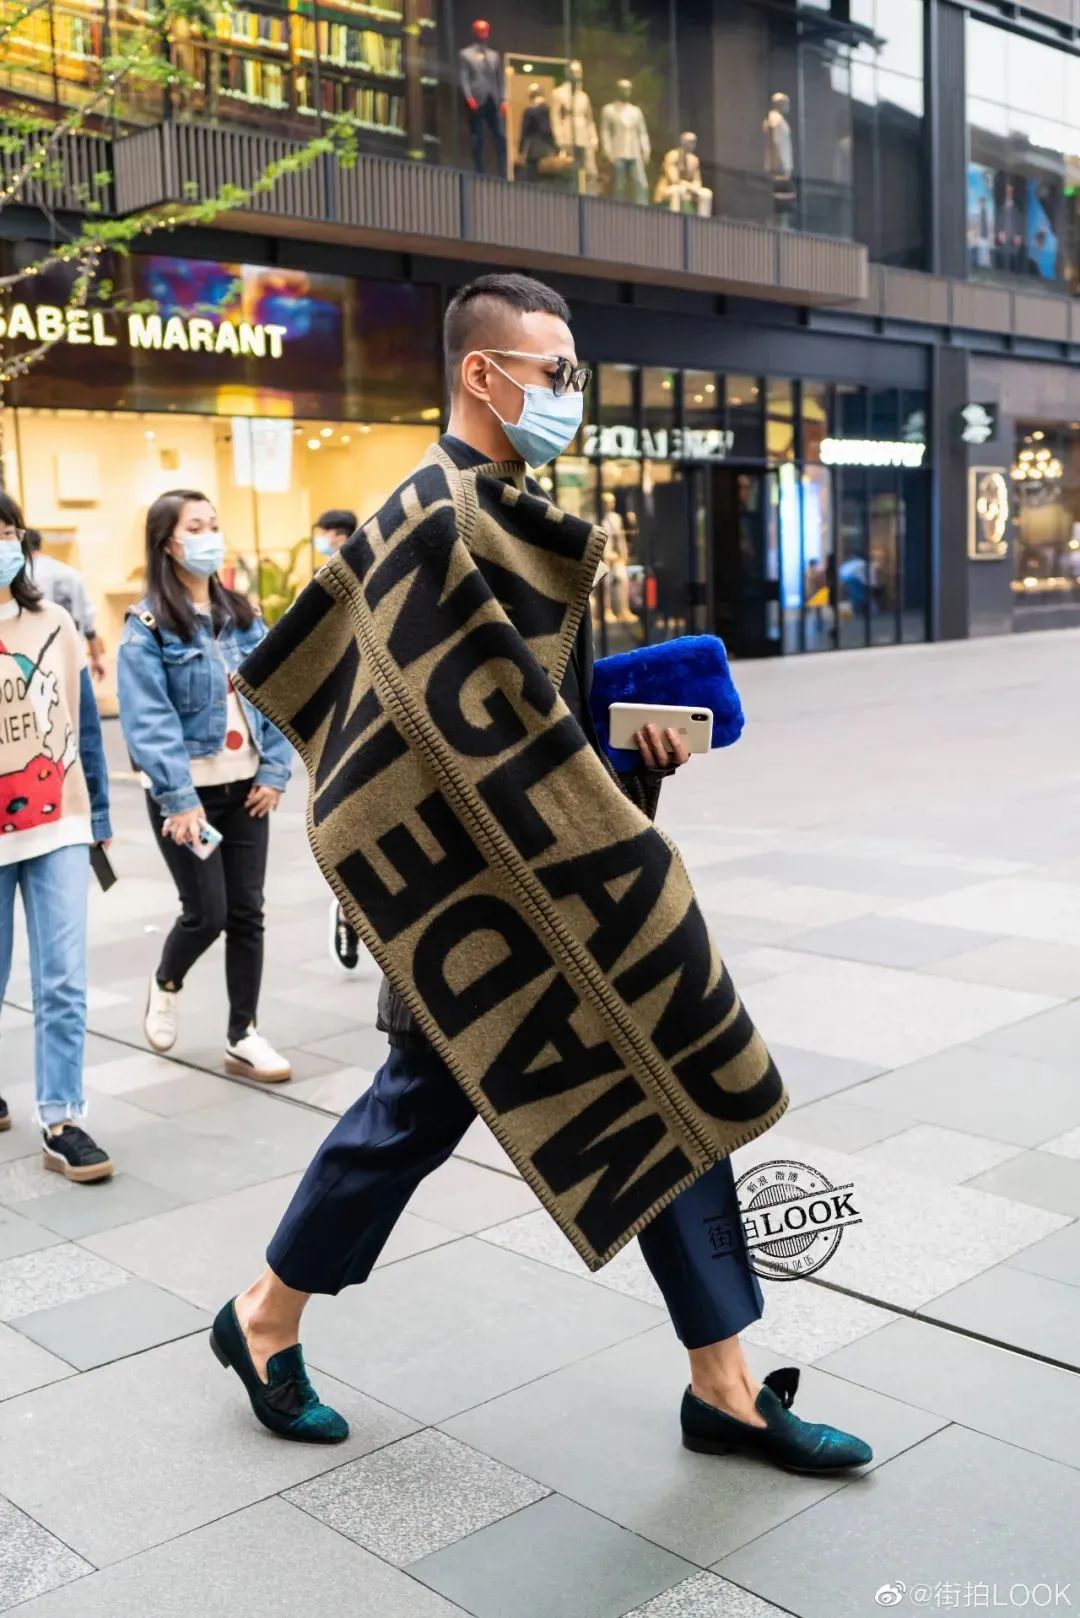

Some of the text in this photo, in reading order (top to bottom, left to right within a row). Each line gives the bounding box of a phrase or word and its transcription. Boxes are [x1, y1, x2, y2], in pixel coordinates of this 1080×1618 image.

[128, 312, 287, 358] MARANT
[0, 711, 38, 744] IEF!
[339, 463, 785, 1122] ENGLAND
[335, 790, 695, 1253] MADE
